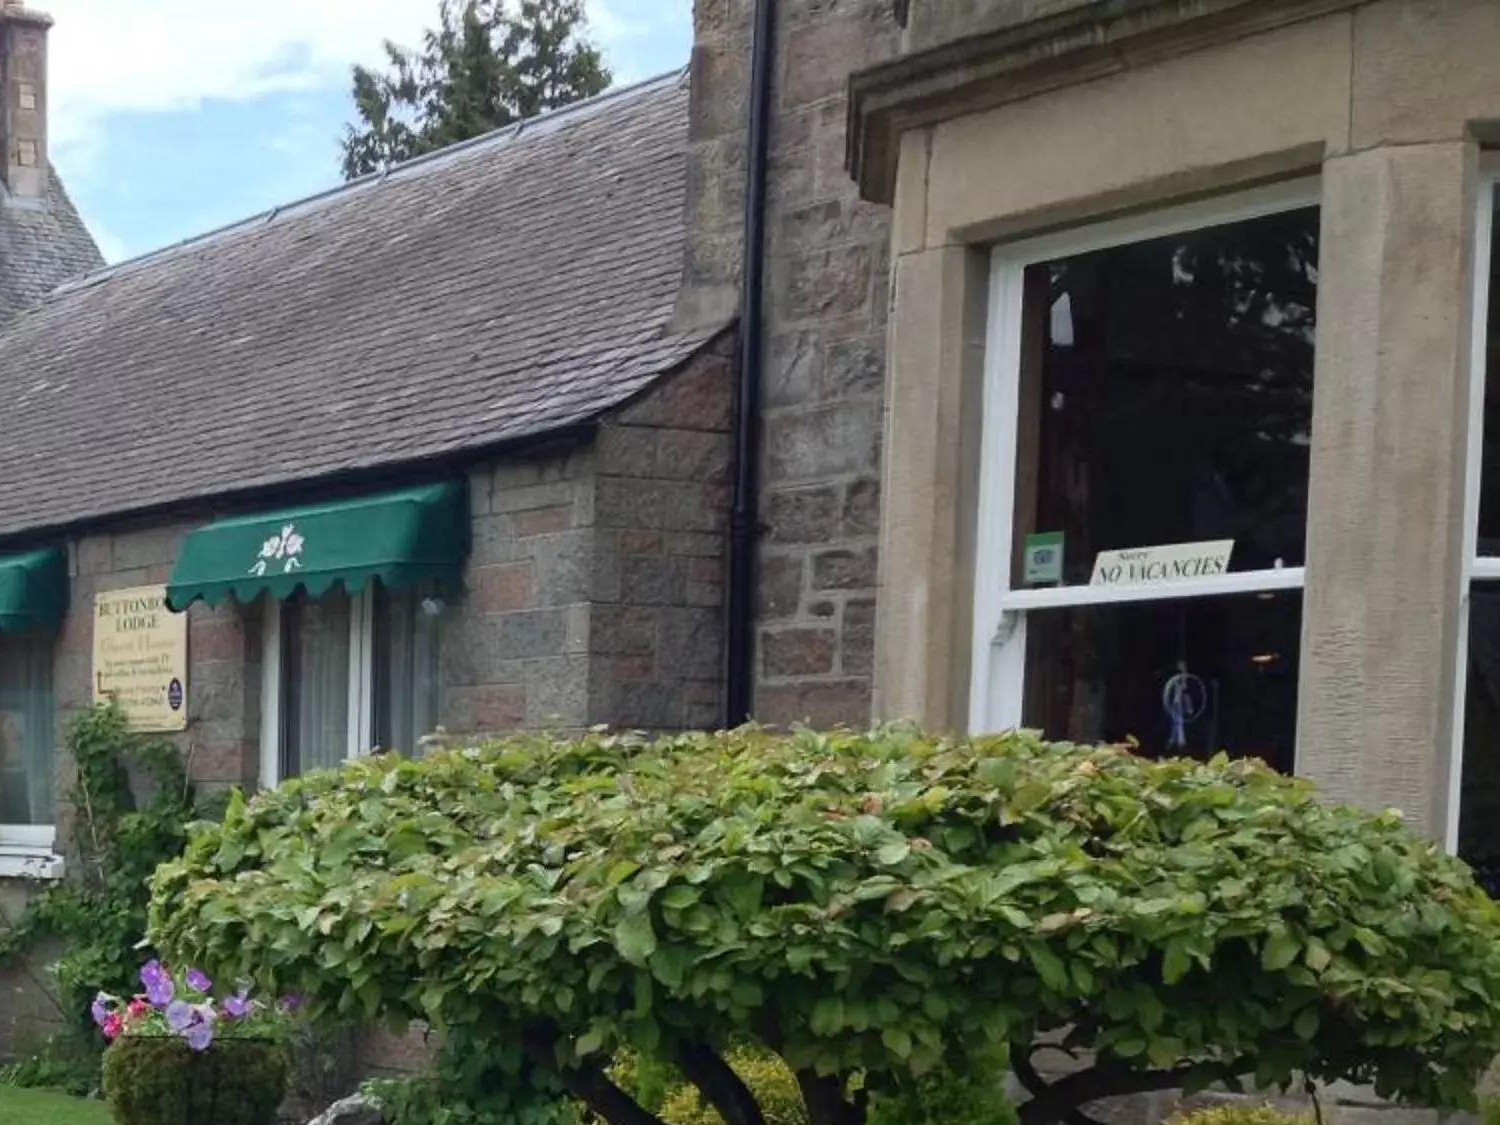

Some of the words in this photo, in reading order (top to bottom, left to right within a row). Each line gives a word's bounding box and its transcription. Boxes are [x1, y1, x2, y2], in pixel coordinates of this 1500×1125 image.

[1099, 565, 1123, 584] NO
[1128, 555, 1226, 582] VACANCIES
[115, 613, 160, 632] LODGE
